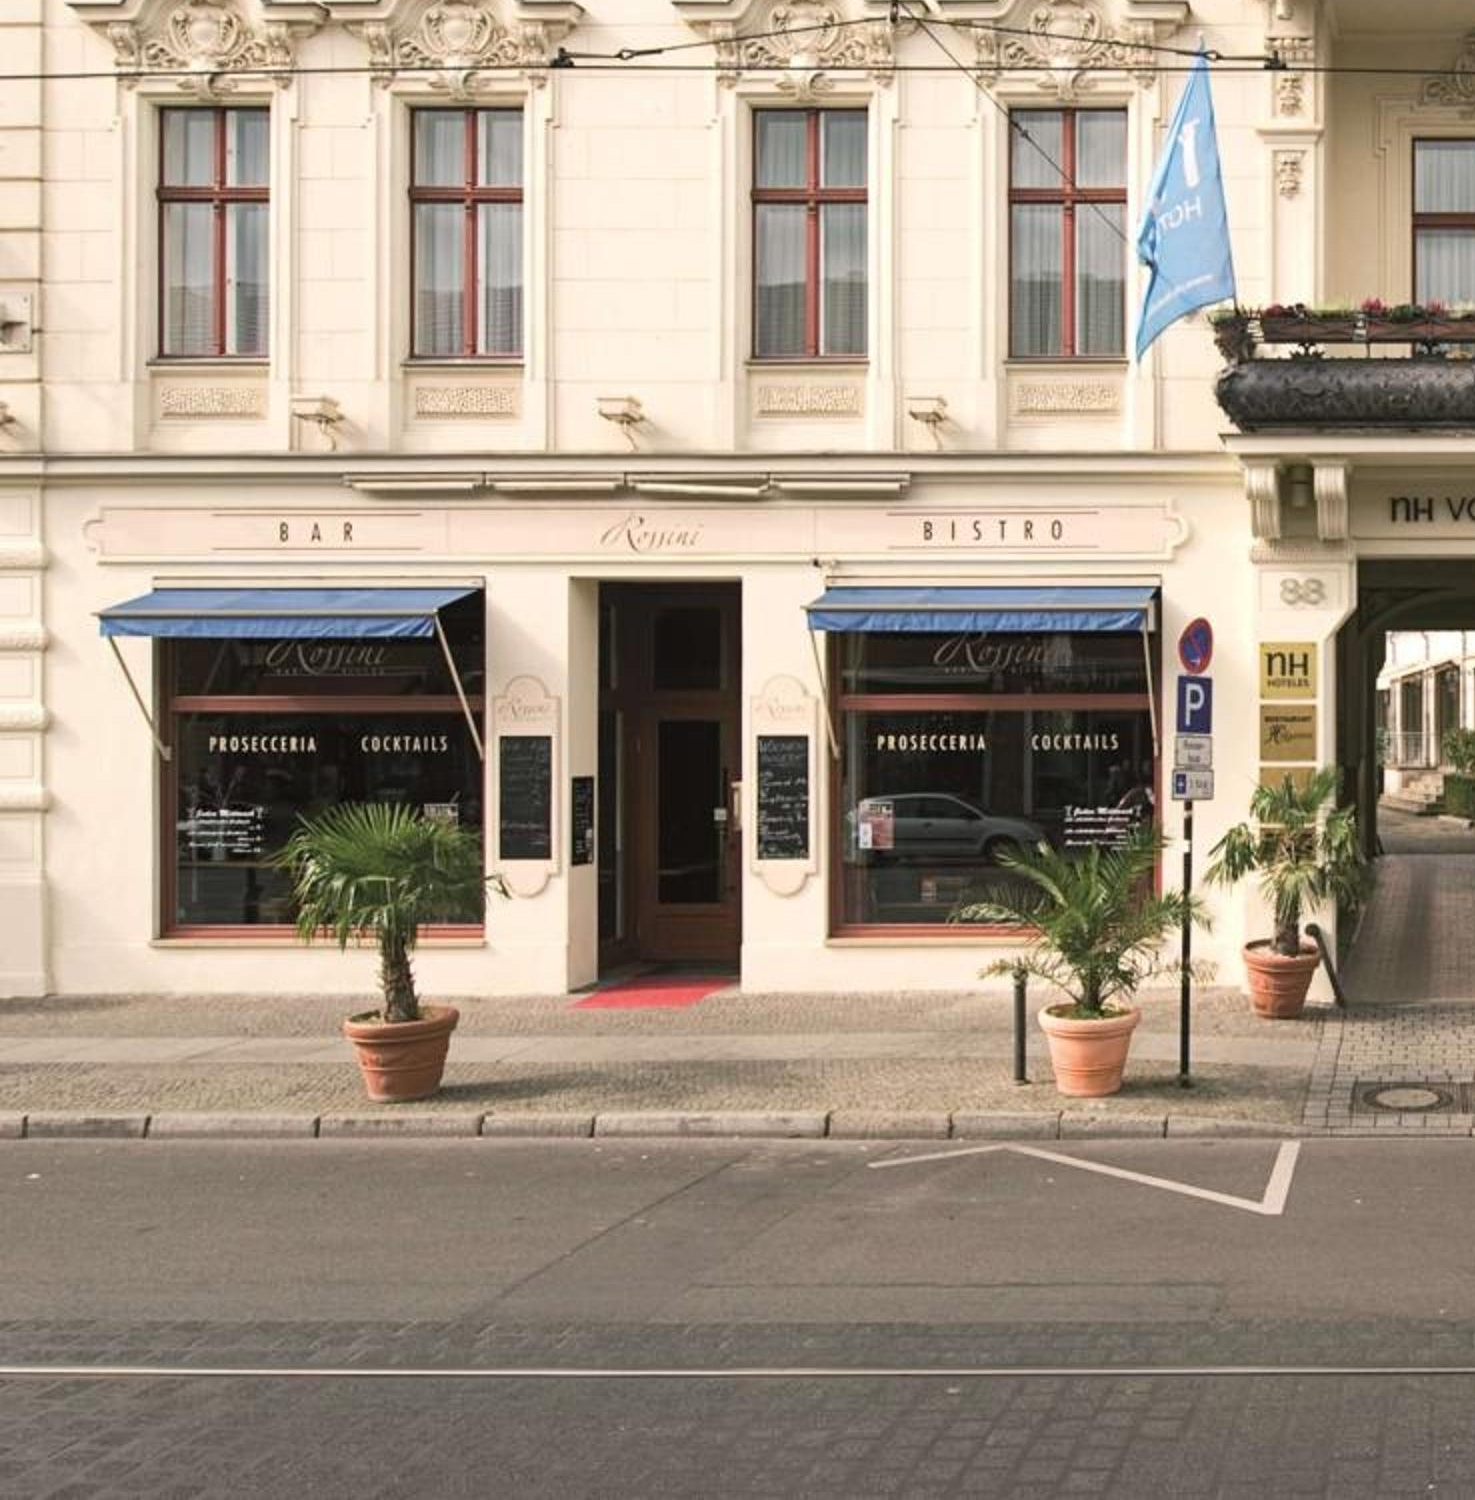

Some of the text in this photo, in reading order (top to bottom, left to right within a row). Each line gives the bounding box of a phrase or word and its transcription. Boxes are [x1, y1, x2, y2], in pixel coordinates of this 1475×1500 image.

[279, 521, 353, 542] BAR
[923, 520, 1063, 541] BISTRO
[1280, 578, 1328, 605] 88
[1185, 683, 1205, 727] P
[209, 735, 448, 752] PROSECCERIA COCKTAILS
[877, 734, 1120, 750] PROSECCERIA COCKTAILS
